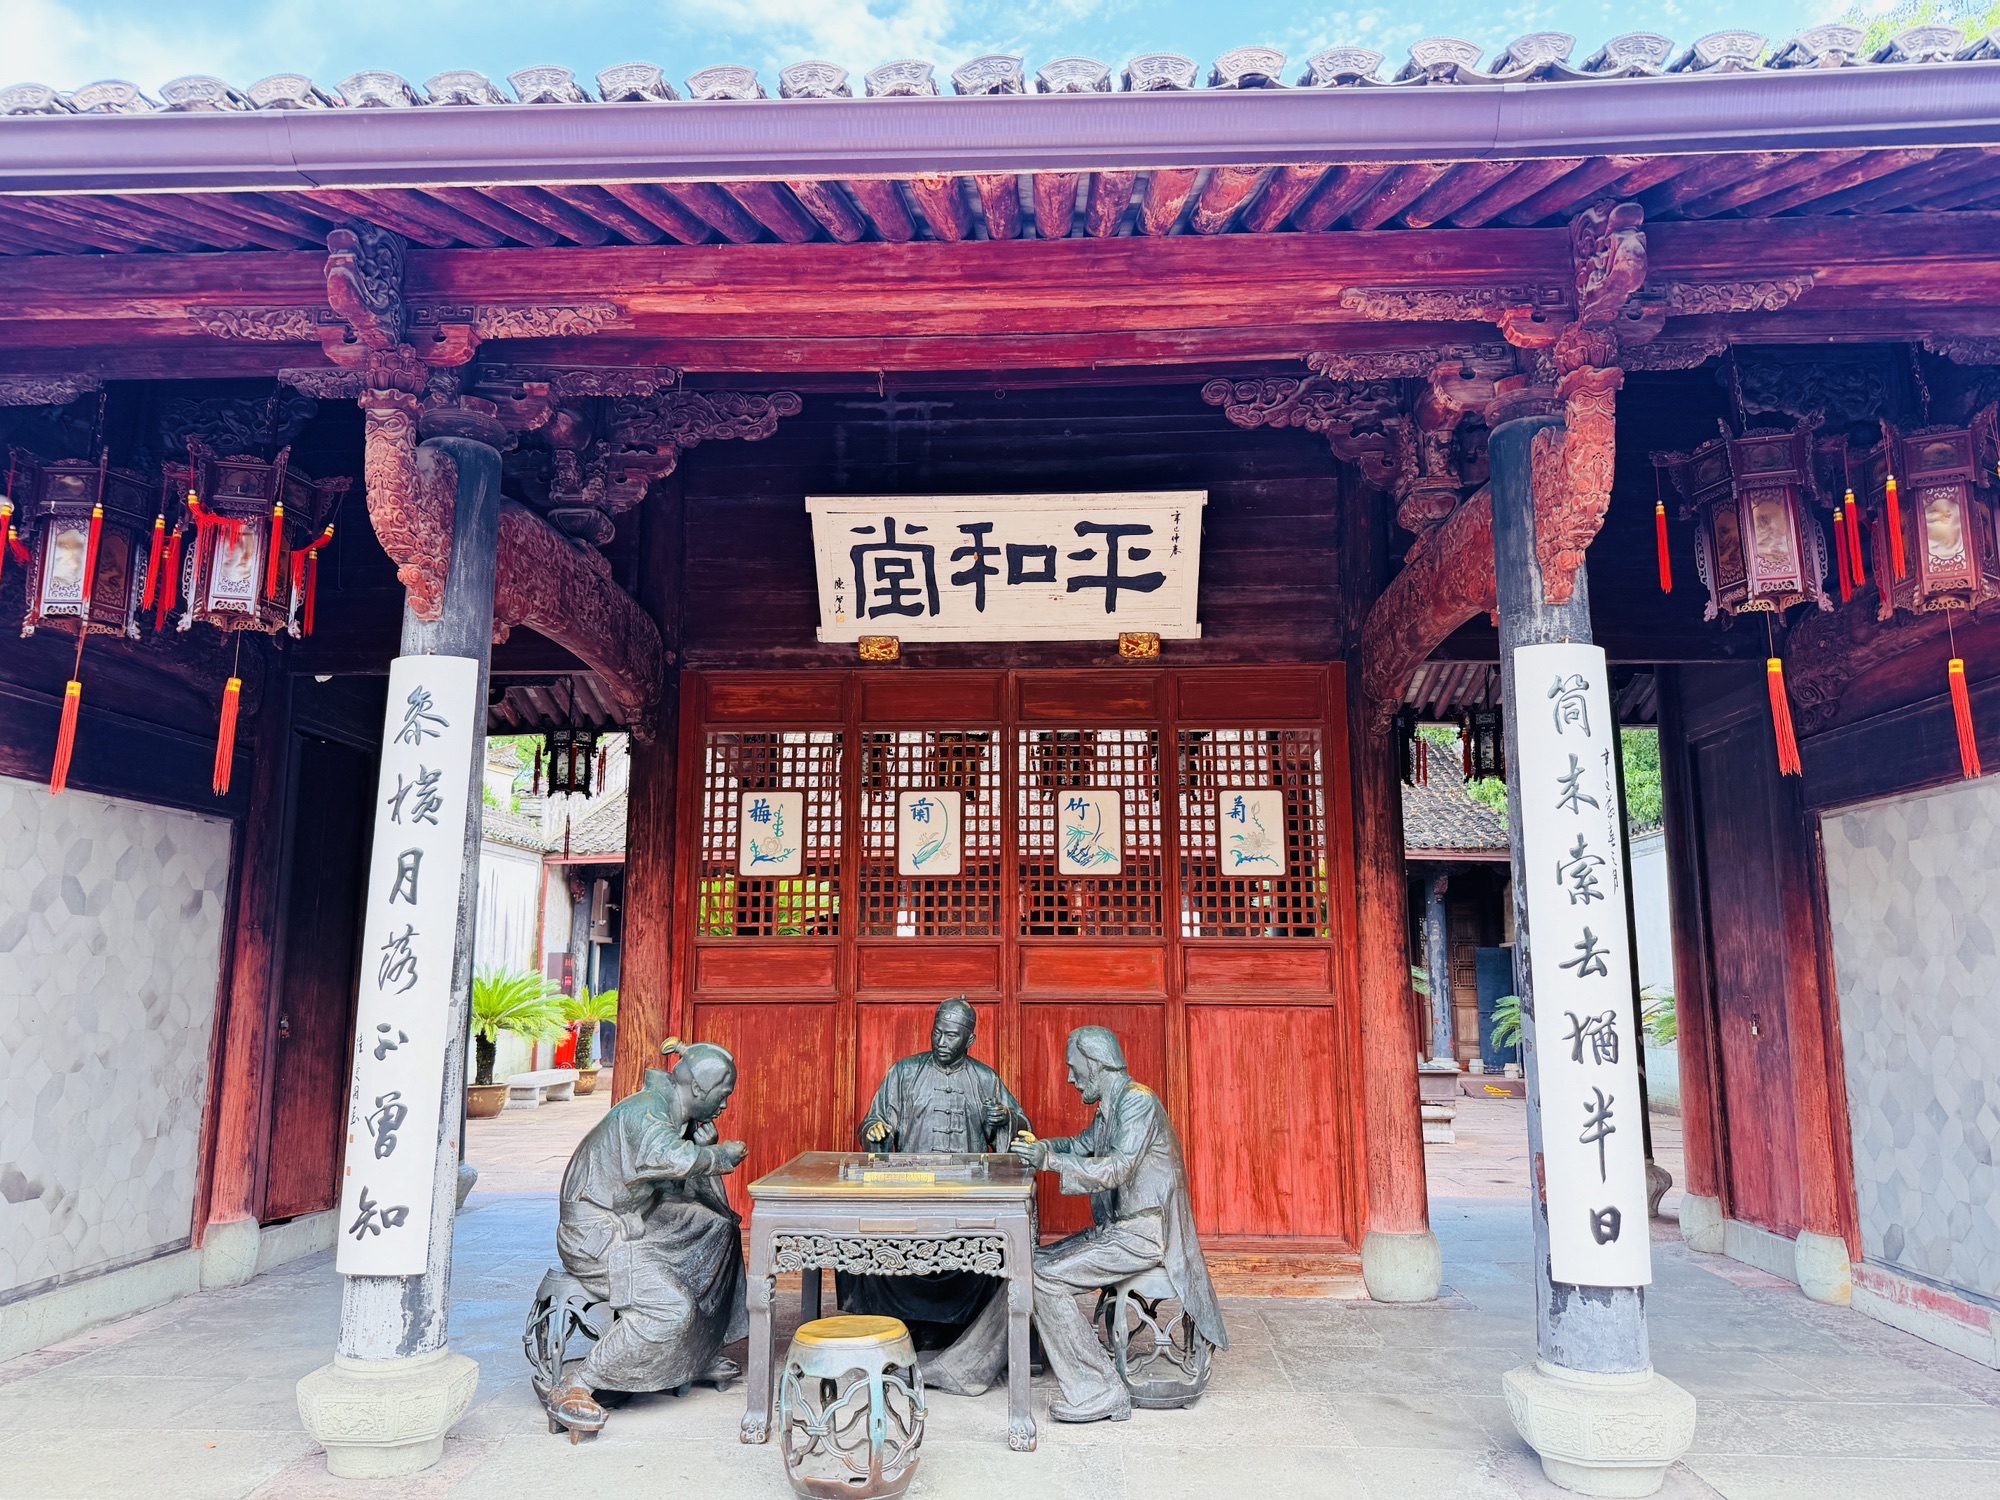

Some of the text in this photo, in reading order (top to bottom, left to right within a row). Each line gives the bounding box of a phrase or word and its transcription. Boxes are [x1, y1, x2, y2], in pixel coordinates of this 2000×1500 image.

[850, 516, 1167, 619] 平和堂
[747, 798, 772, 824] 梅
[1064, 796, 1091, 821] 竹
[1225, 795, 1247, 824] 菊
